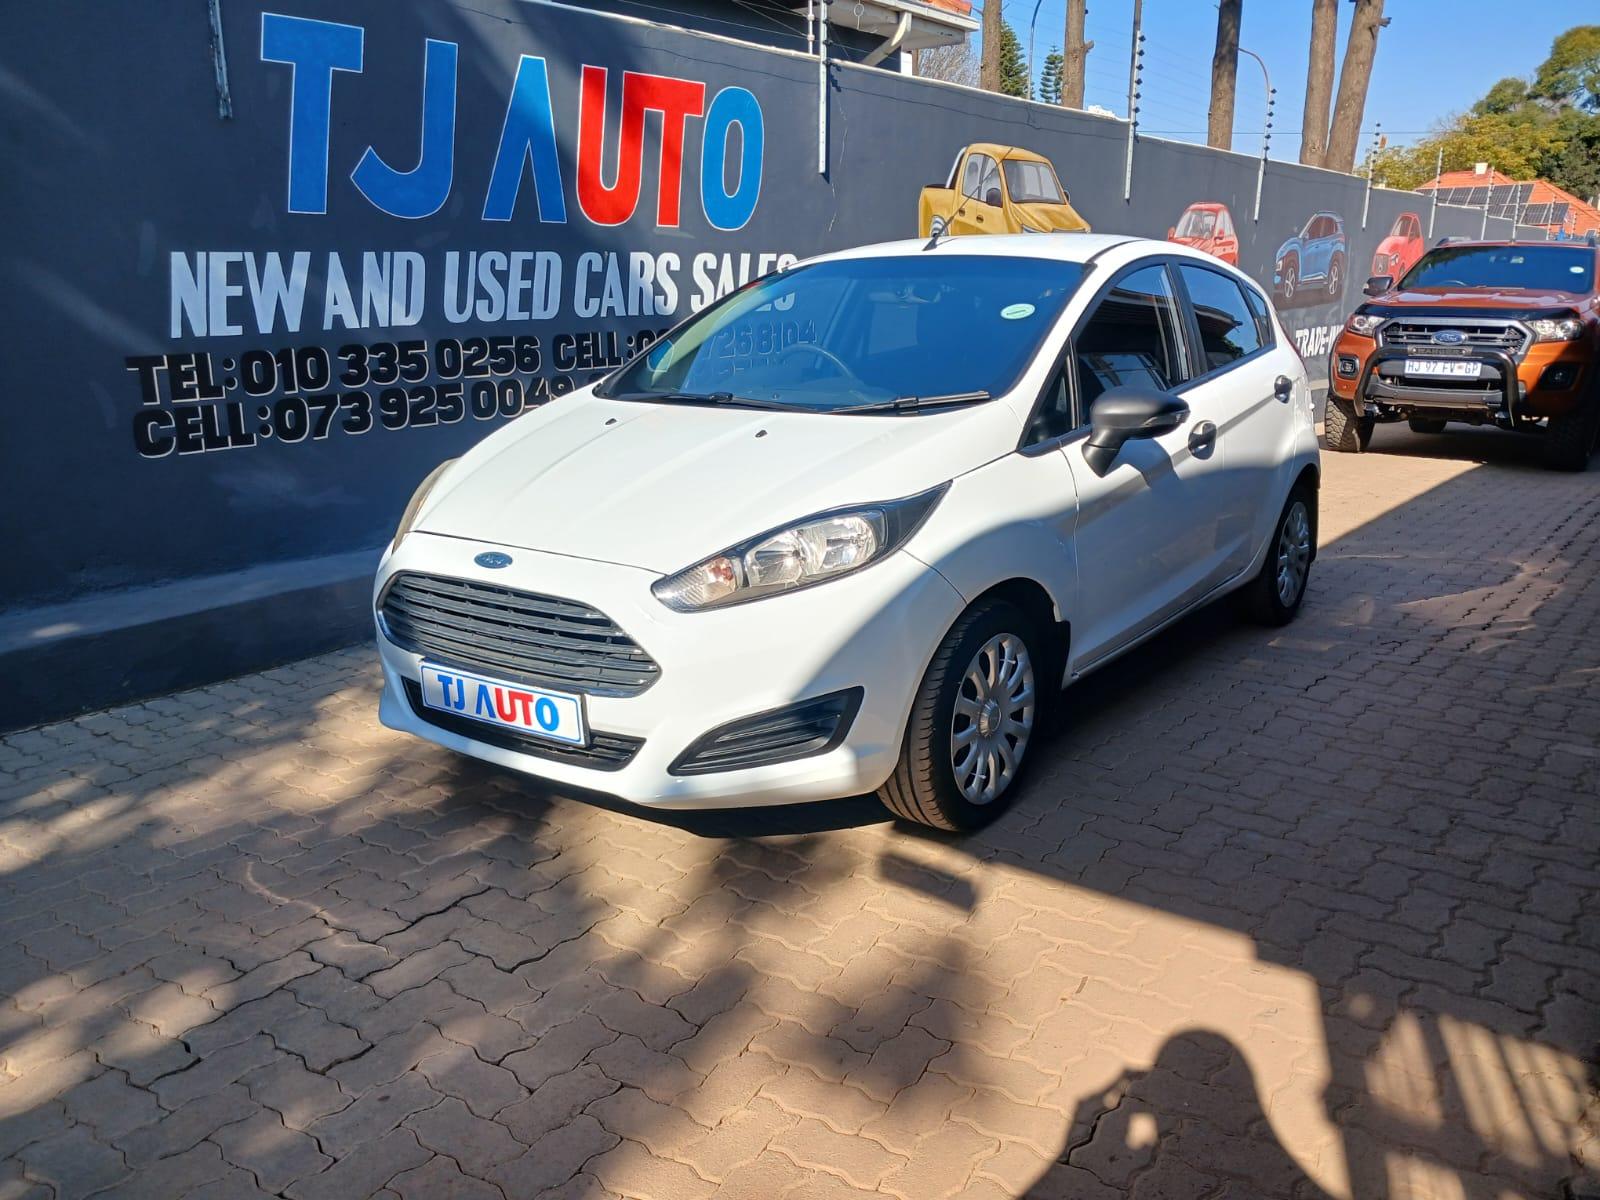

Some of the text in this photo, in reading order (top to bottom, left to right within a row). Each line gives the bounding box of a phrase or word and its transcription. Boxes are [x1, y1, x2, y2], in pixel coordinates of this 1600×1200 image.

[260, 11, 765, 232] TJ AUTO
[170, 250, 311, 339] NEW
[322, 251, 426, 331] AND
[443, 250, 563, 324] USED
[573, 251, 681, 318] CARS
[337, 340, 430, 389] 335
[435, 335, 542, 381] 0256
[1464, 362, 1480, 374] GP
[379, 382, 466, 431] 925
[437, 673, 560, 733] TJ AUTO
